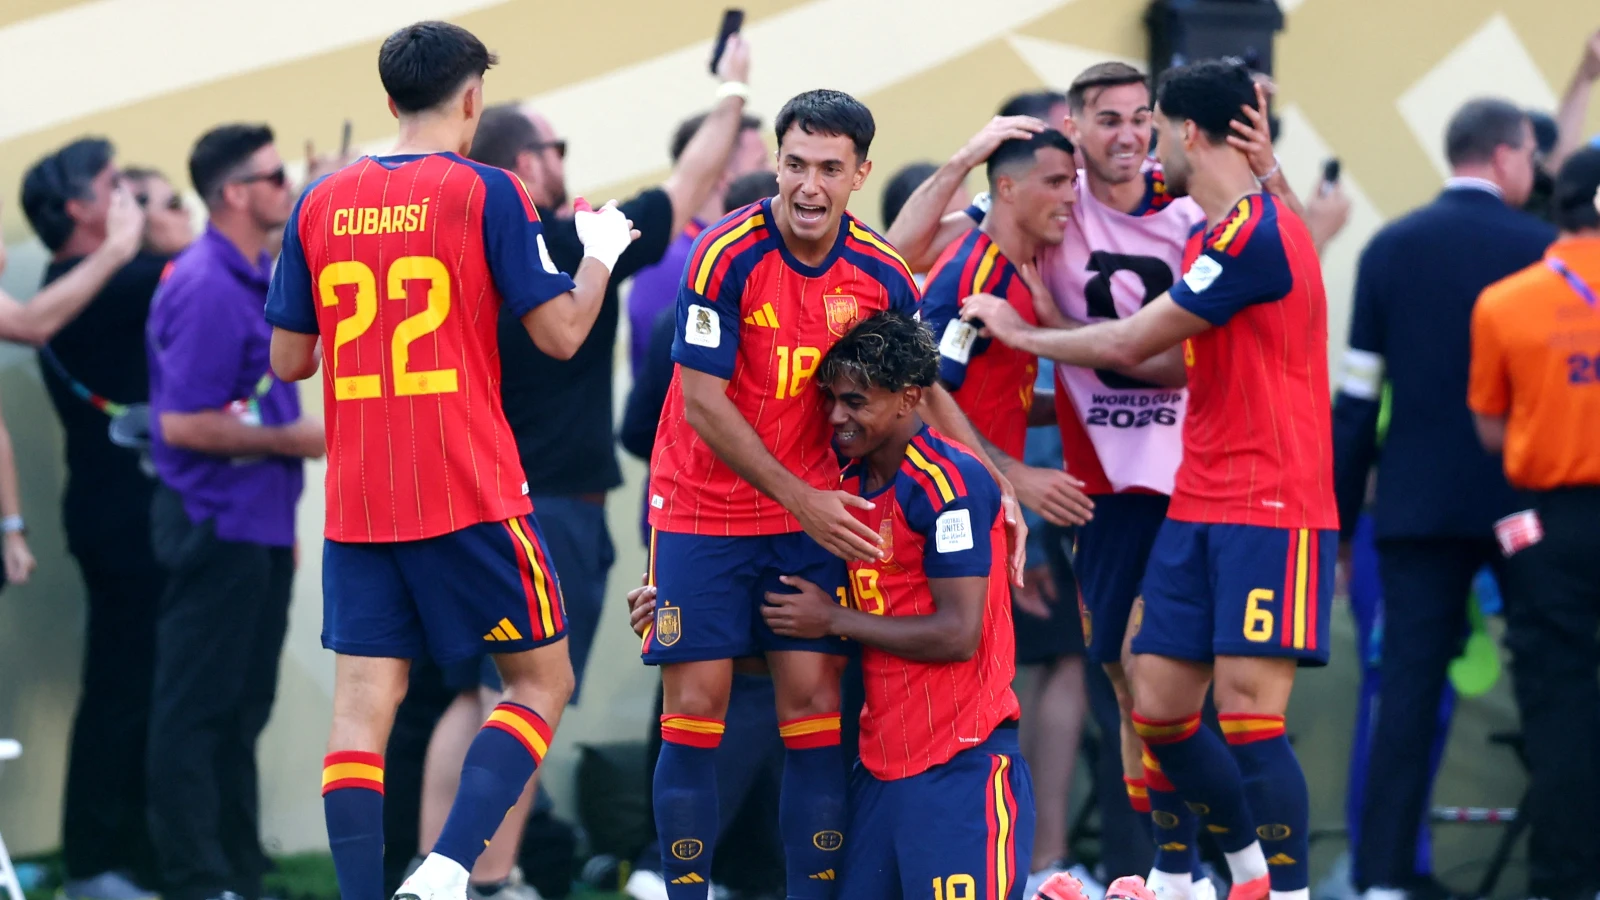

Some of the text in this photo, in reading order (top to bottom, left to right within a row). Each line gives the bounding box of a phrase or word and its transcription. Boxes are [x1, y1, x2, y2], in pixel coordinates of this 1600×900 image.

[333, 197, 430, 236] CUBARSÍ
[318, 255, 458, 401] 22
[774, 346, 821, 399] 18
[1086, 407, 1177, 429] 2026
[1092, 393, 1181, 407] WORLD CUP
[942, 523, 964, 532] UNITES
[850, 568, 884, 616] 19
[1243, 588, 1275, 643] 6
